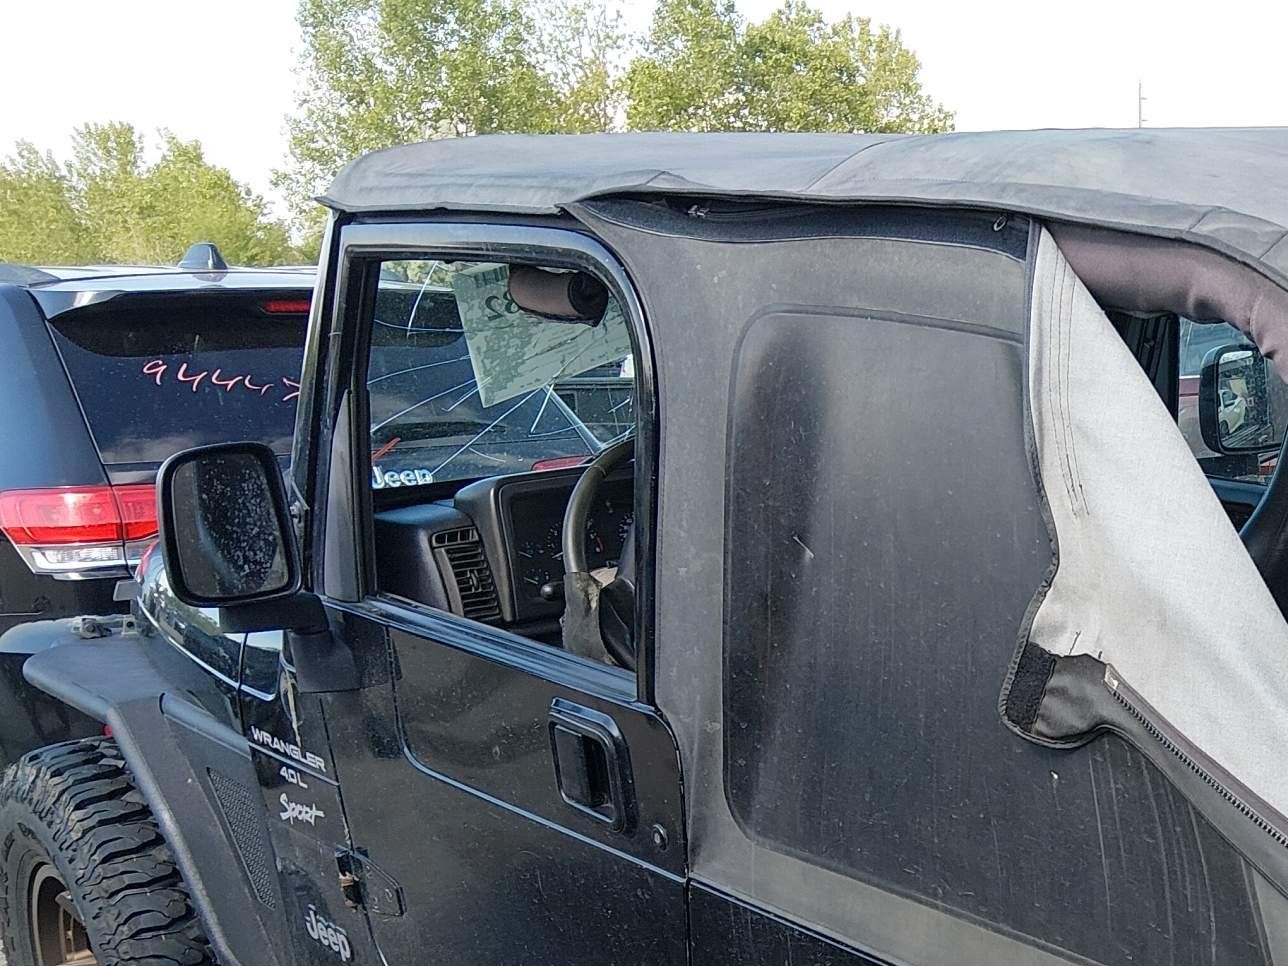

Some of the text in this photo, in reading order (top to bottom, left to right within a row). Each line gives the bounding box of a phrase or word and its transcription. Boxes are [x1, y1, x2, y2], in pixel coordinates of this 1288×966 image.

[371, 465, 433, 489] Jeep
[250, 725, 327, 773] WRANGLER
[279, 792, 325, 826] Sport
[304, 903, 352, 962] Jeep
